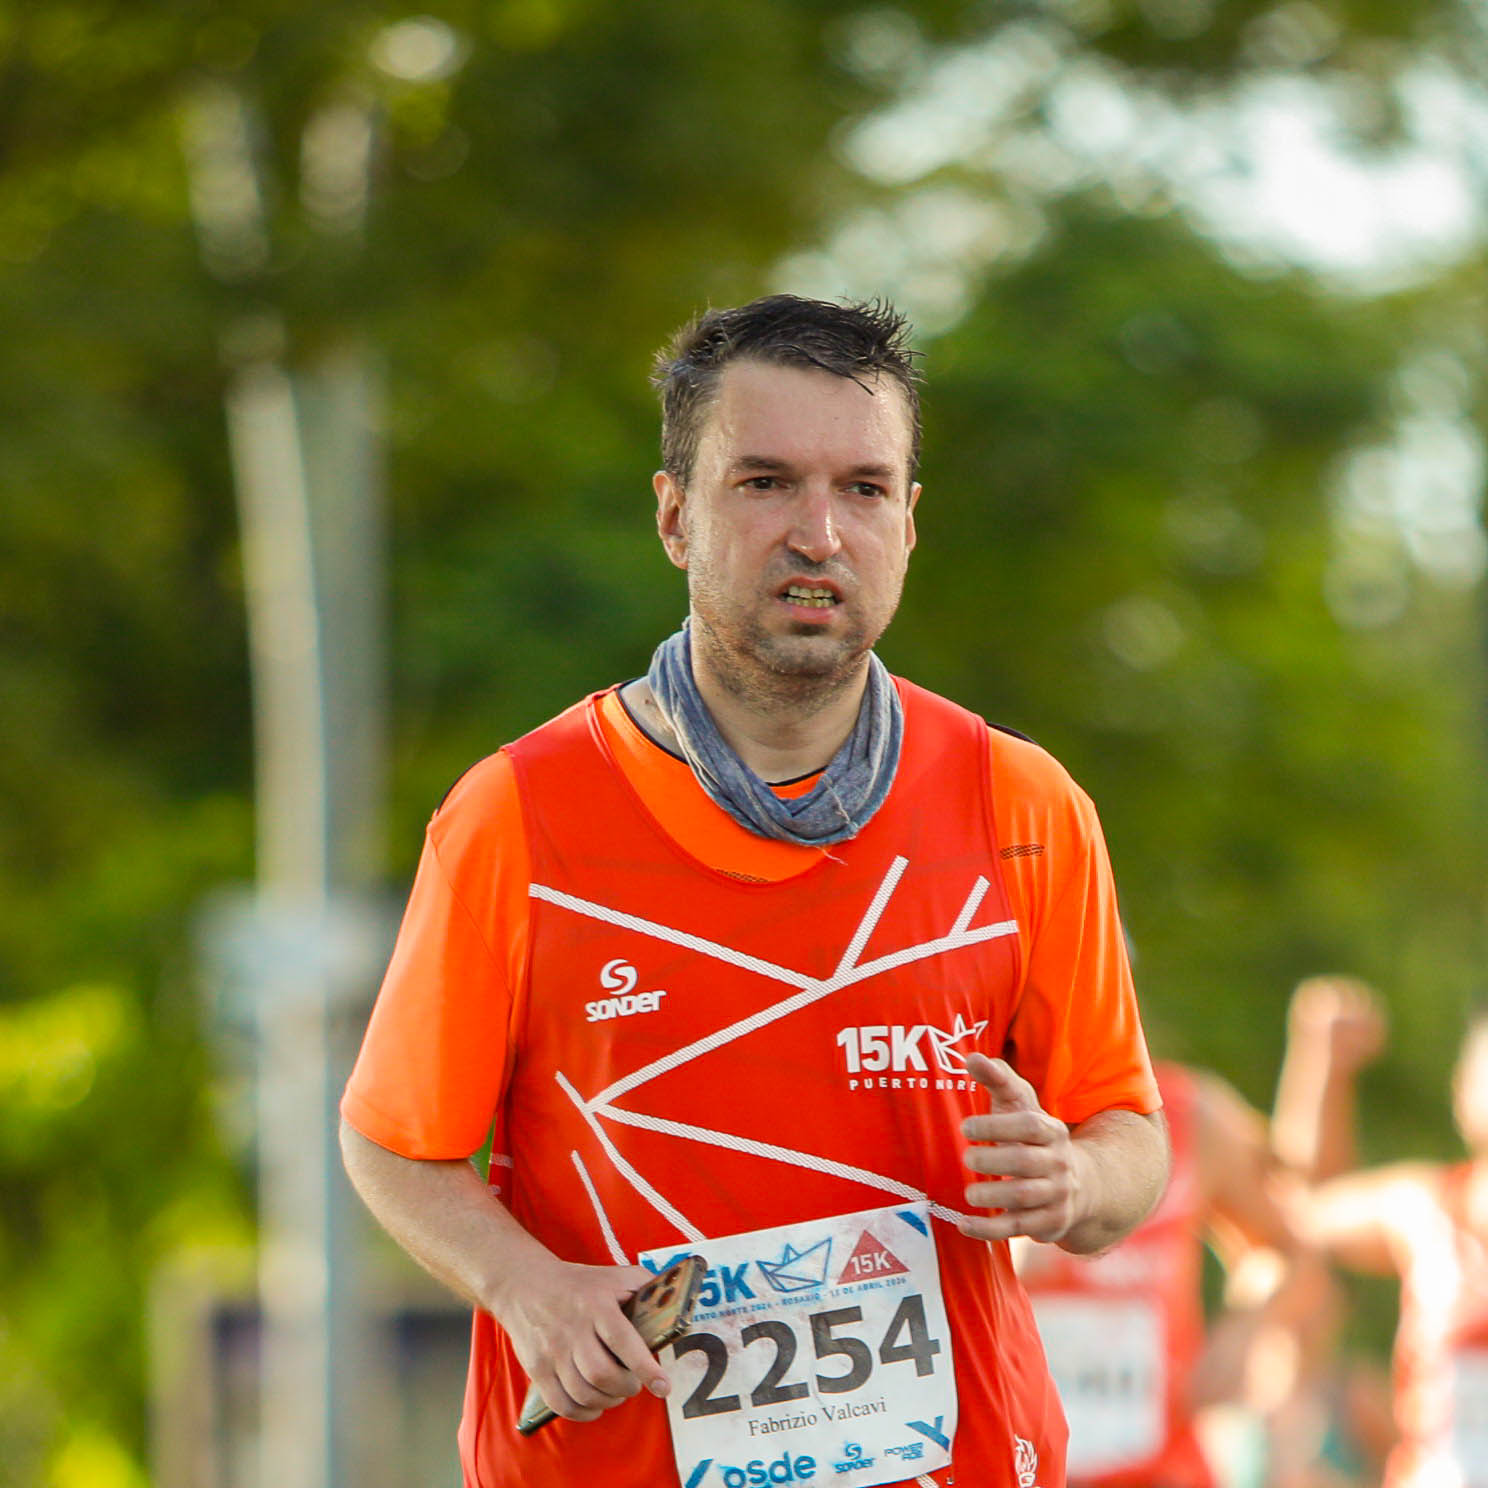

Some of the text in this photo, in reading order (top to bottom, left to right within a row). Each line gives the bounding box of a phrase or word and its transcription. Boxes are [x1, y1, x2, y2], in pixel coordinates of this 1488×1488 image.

[837, 1025, 928, 1073] 15K
[849, 1077, 977, 1092] PUERTO NORE
[852, 1250, 891, 1275] 15K
[699, 1263, 756, 1307] 5K
[673, 1294, 941, 1420] 2254
[748, 1396, 887, 1436] Fabrizio Valcavi
